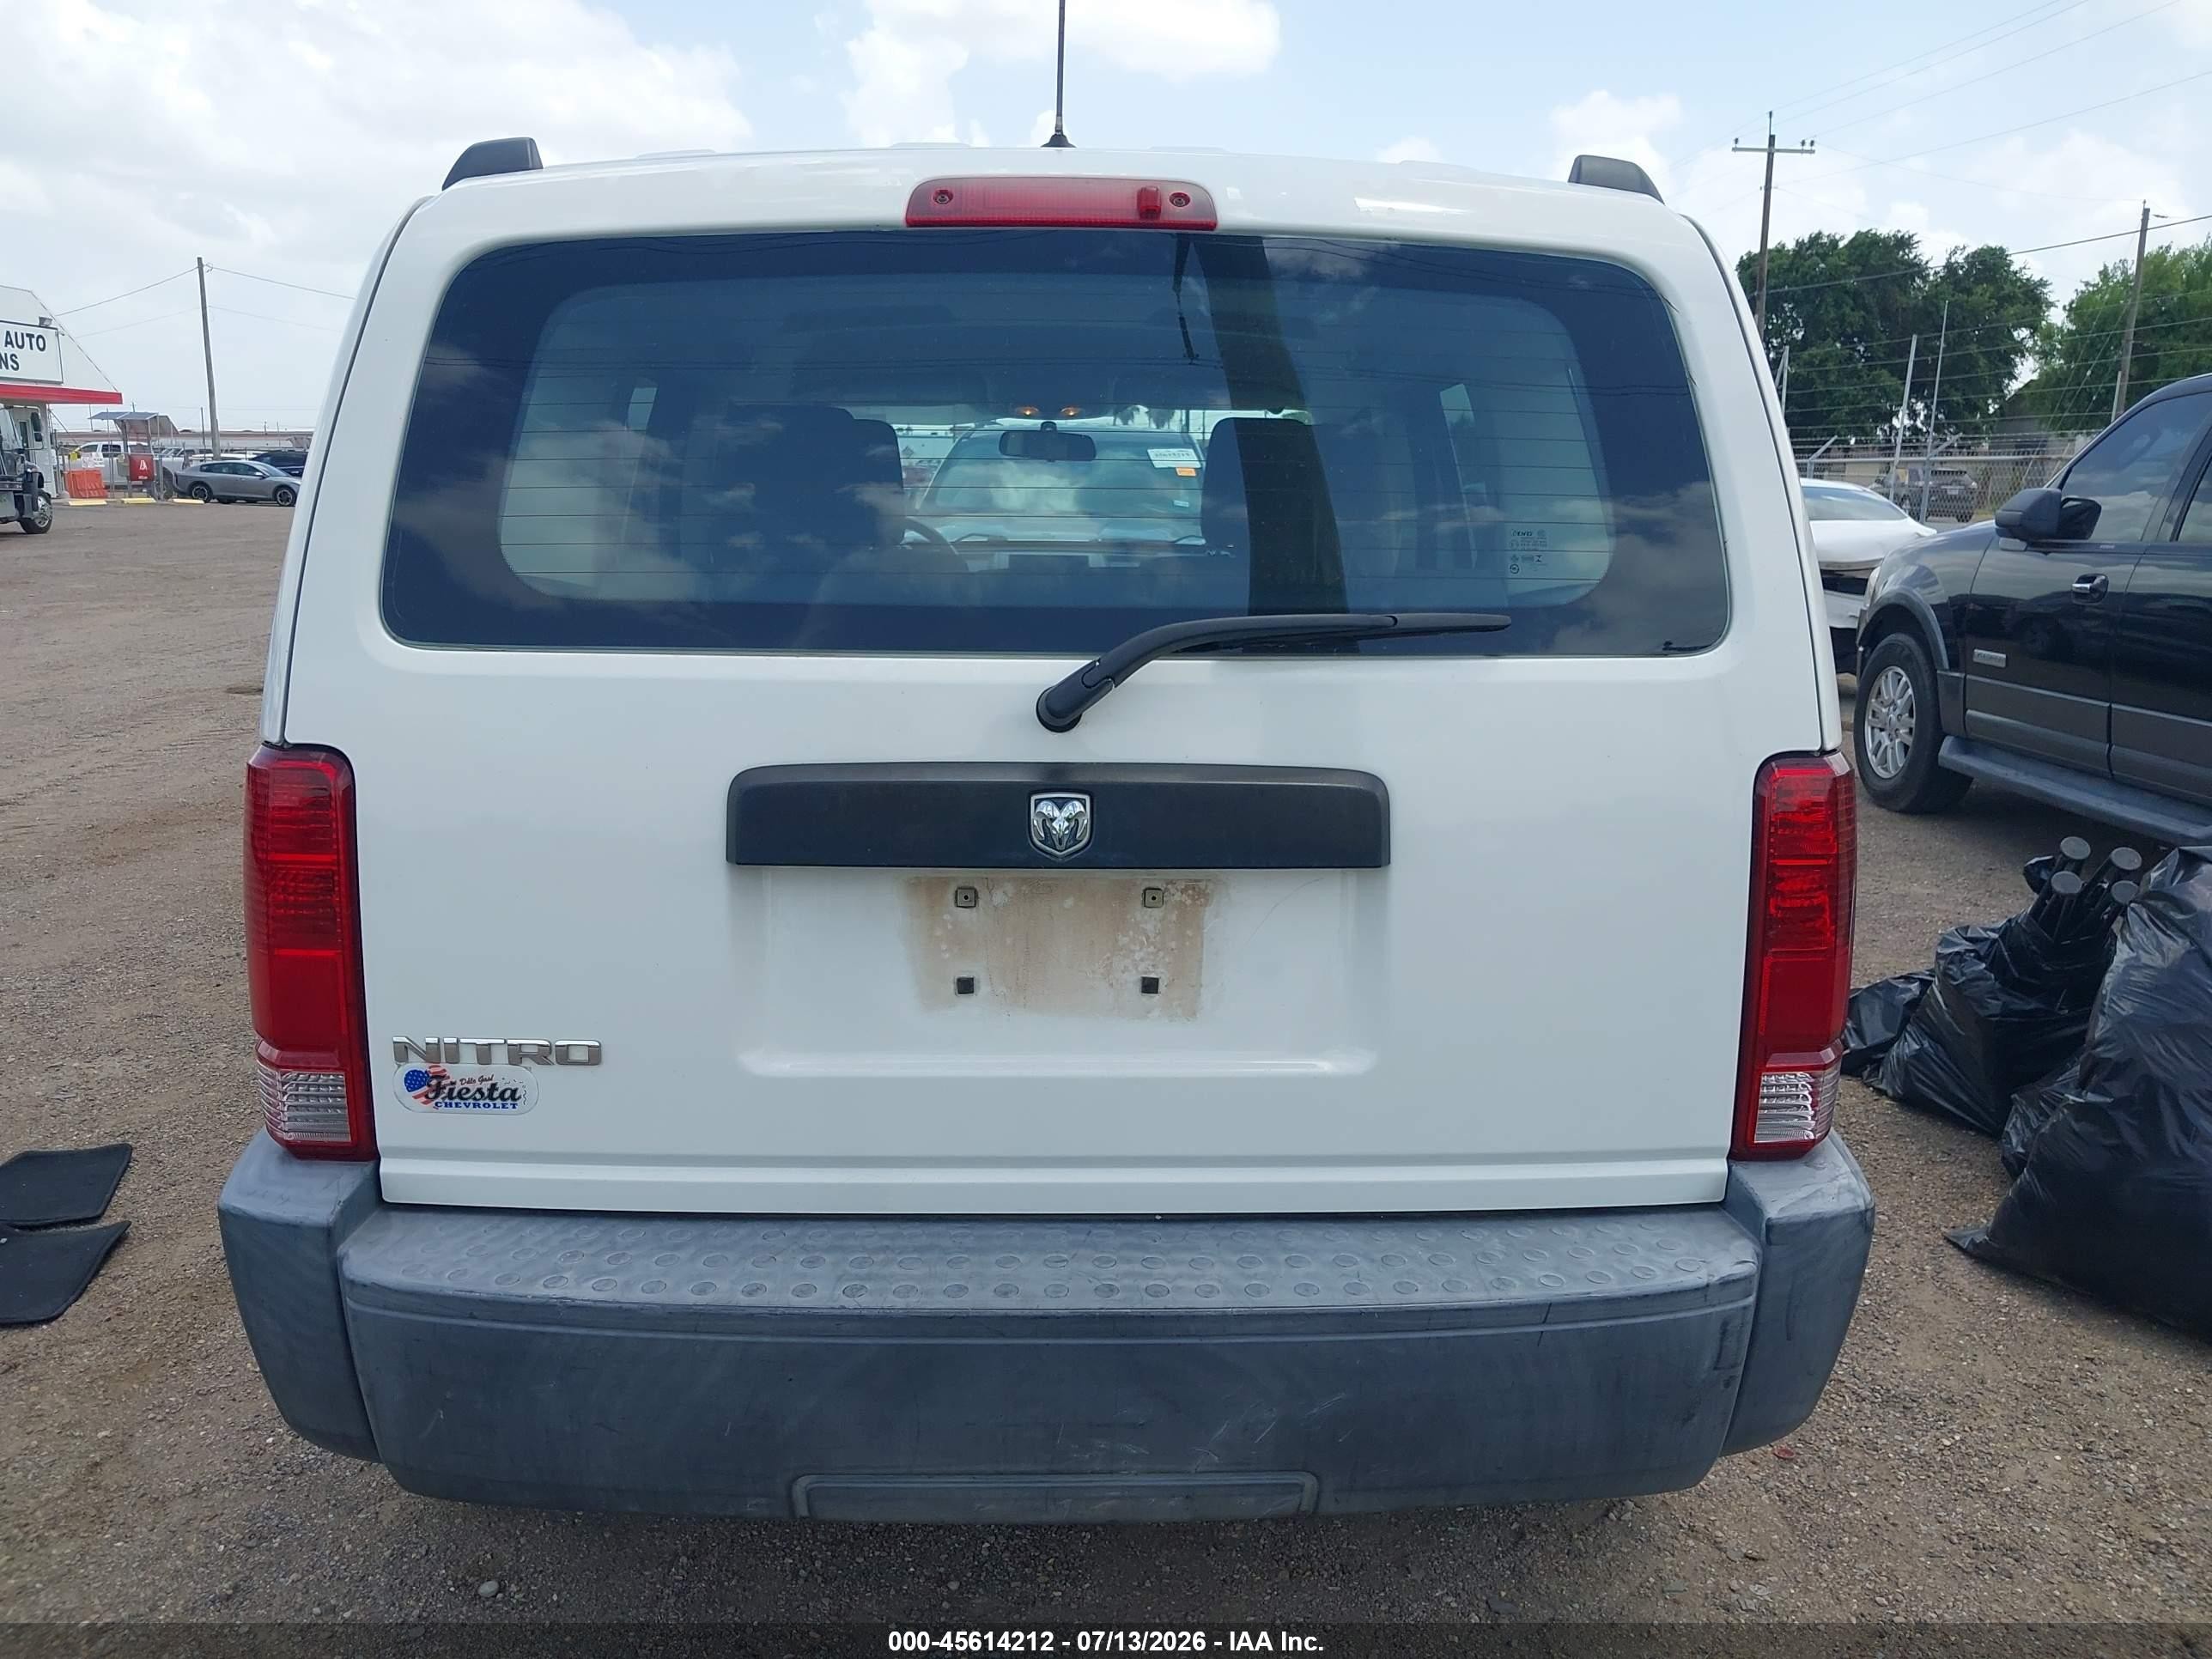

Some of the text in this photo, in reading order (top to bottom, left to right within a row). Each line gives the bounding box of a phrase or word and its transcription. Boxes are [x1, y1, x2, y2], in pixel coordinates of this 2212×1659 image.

[4, 330, 46, 352] AUTO
[392, 1036, 602, 1066] NITRO
[424, 1075, 522, 1102] Fiesta
[434, 1101, 519, 1110] CHEVROLET
